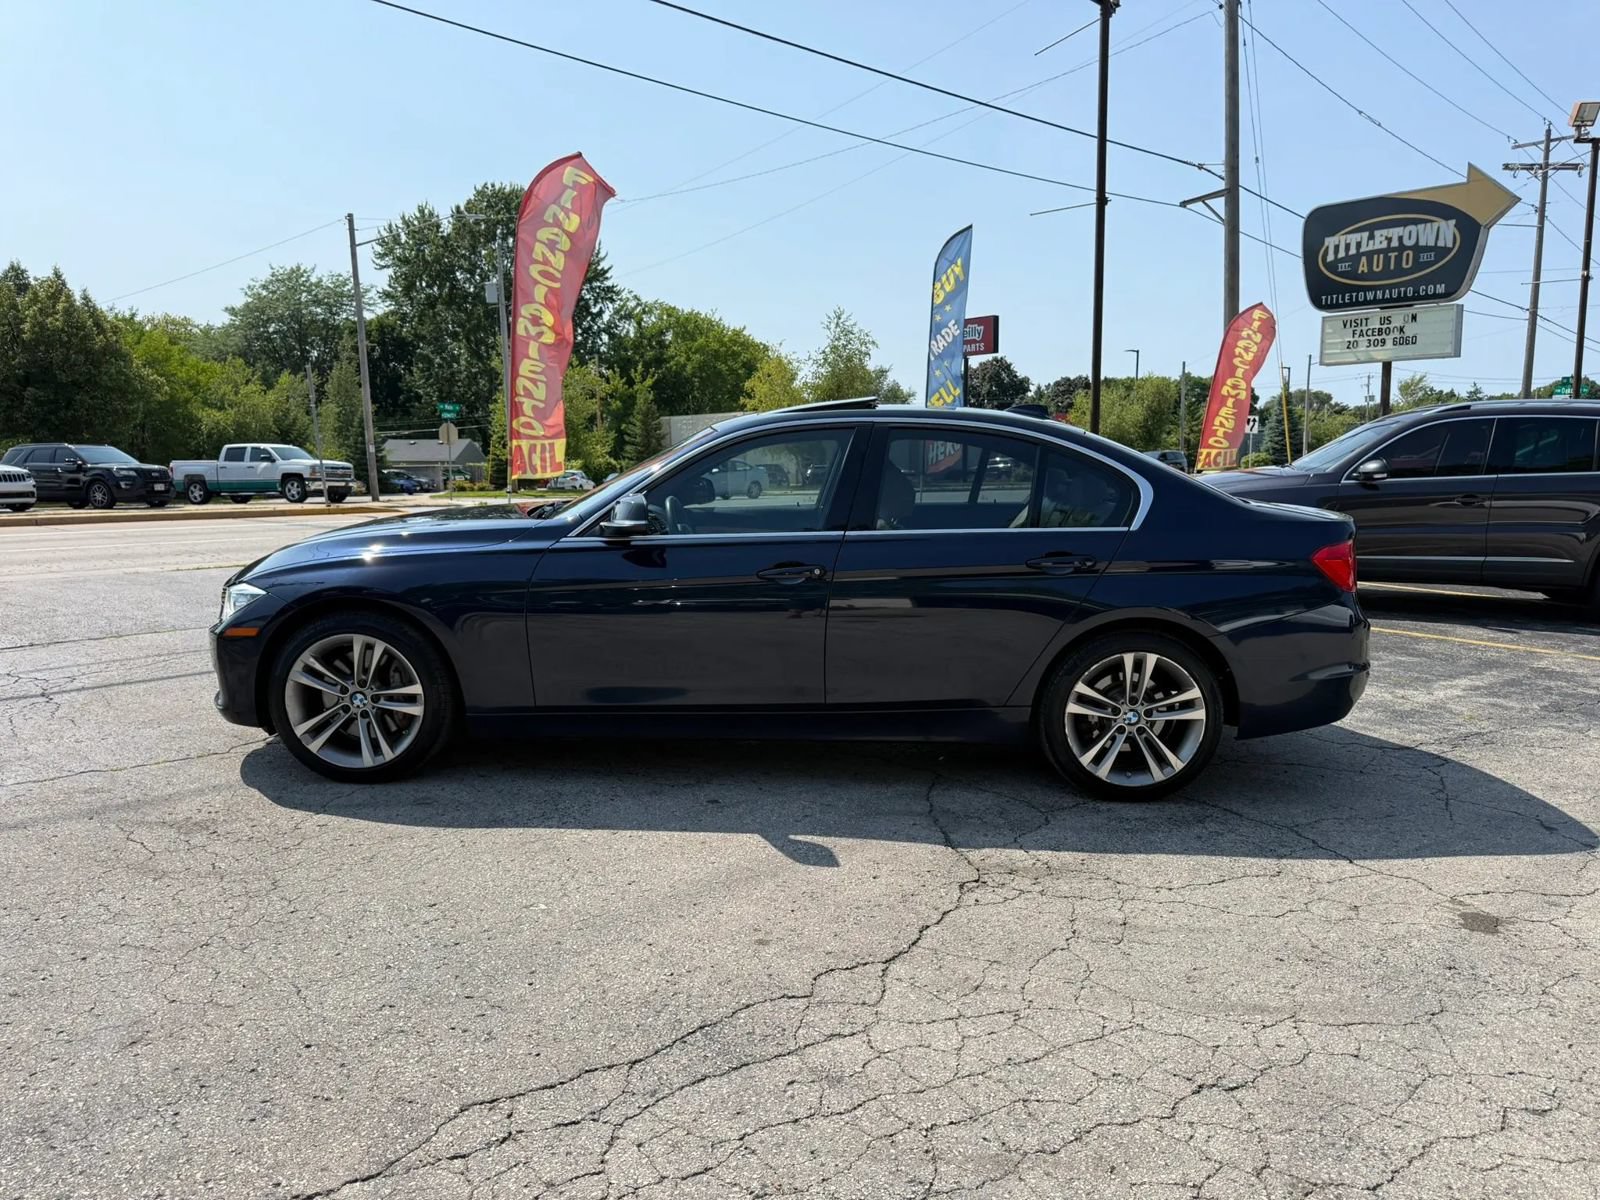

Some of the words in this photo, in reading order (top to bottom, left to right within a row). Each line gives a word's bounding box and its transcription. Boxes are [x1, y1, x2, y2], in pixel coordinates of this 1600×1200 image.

[1324, 219, 1457, 263] TITLETOWN
[1357, 250, 1414, 274] AUTO
[933, 257, 965, 305] BUY
[1321, 284, 1446, 305] TITLETOWNAUTO.COM
[1342, 317, 1370, 330] VISIT
[1379, 315, 1392, 326] US
[1352, 325, 1406, 339] FACEBOOK
[1366, 338, 1387, 349] 309
[1392, 335, 1418, 347] 6060
[927, 380, 960, 408] ELL
